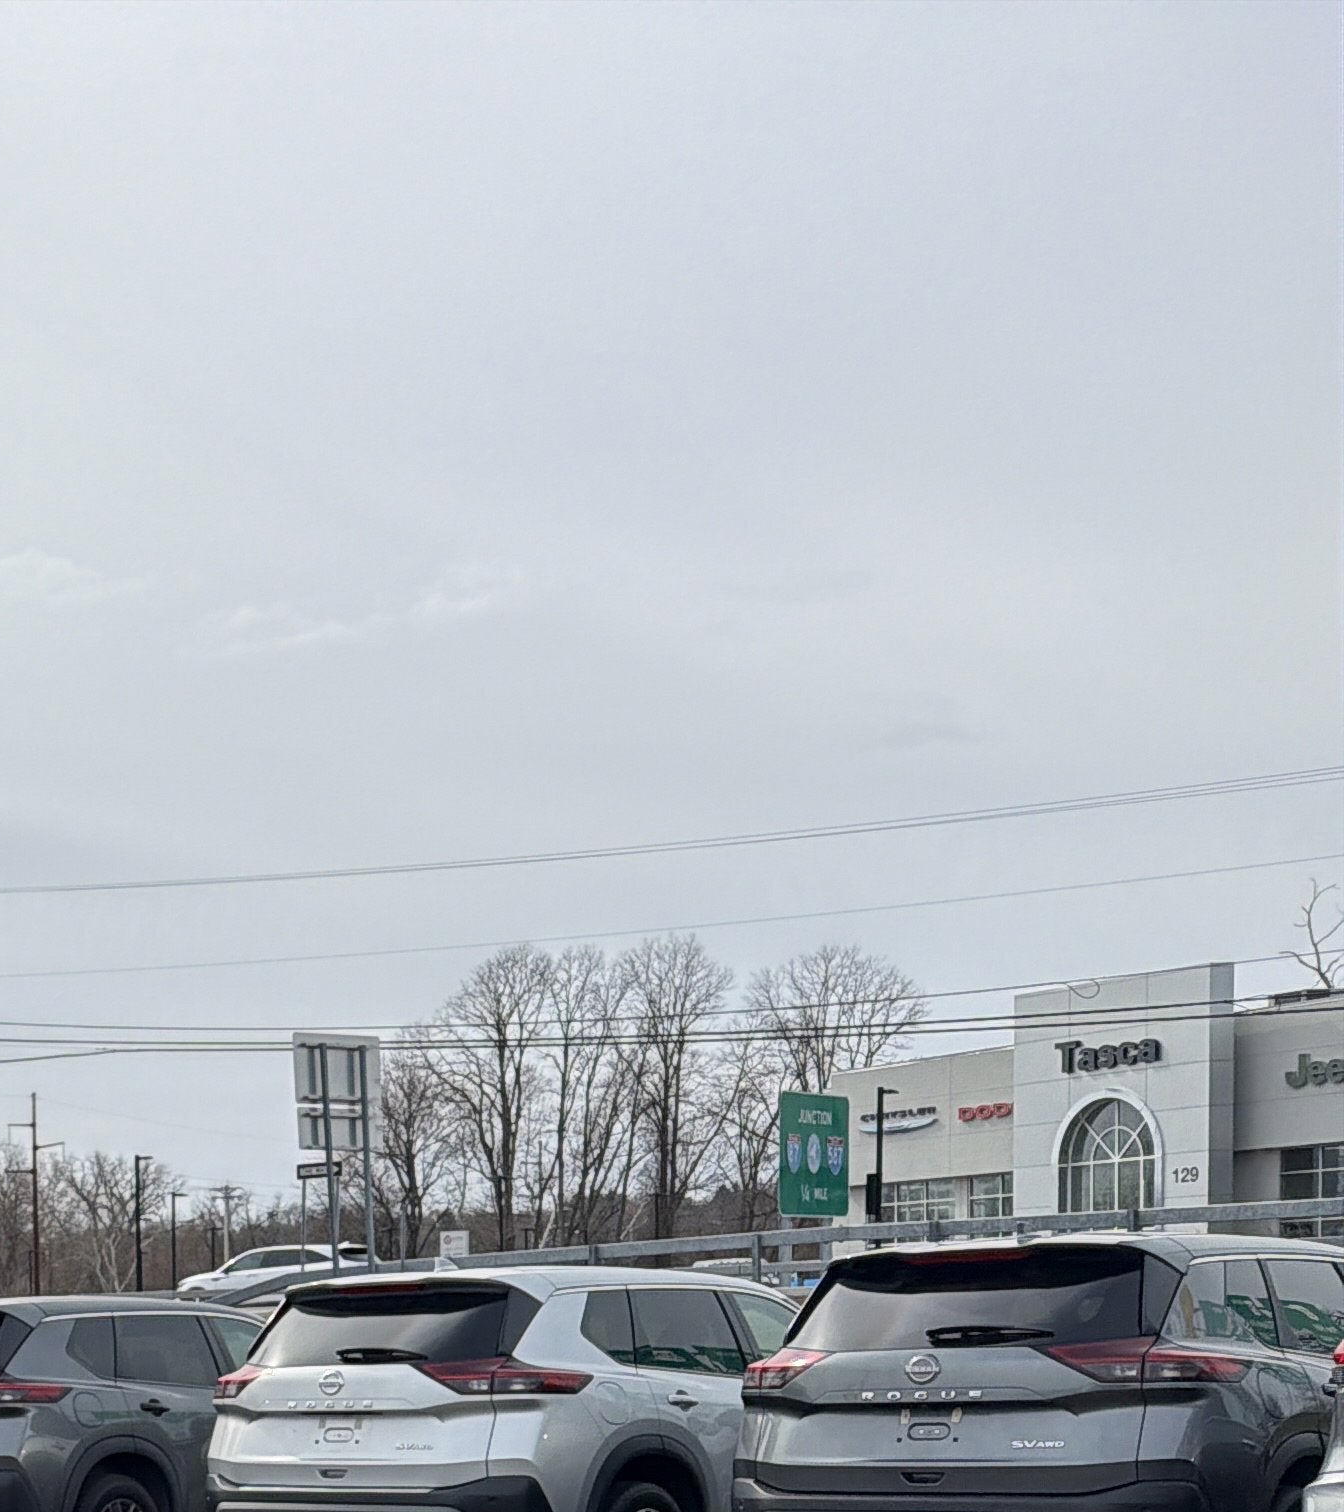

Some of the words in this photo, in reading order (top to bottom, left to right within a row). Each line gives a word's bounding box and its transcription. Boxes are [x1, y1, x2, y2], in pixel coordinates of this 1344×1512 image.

[1055, 1039, 1162, 1074] Tasca
[959, 1103, 1014, 1122] DOD
[1172, 1167, 1200, 1184] 129
[861, 1389, 983, 1401] ROGUE
